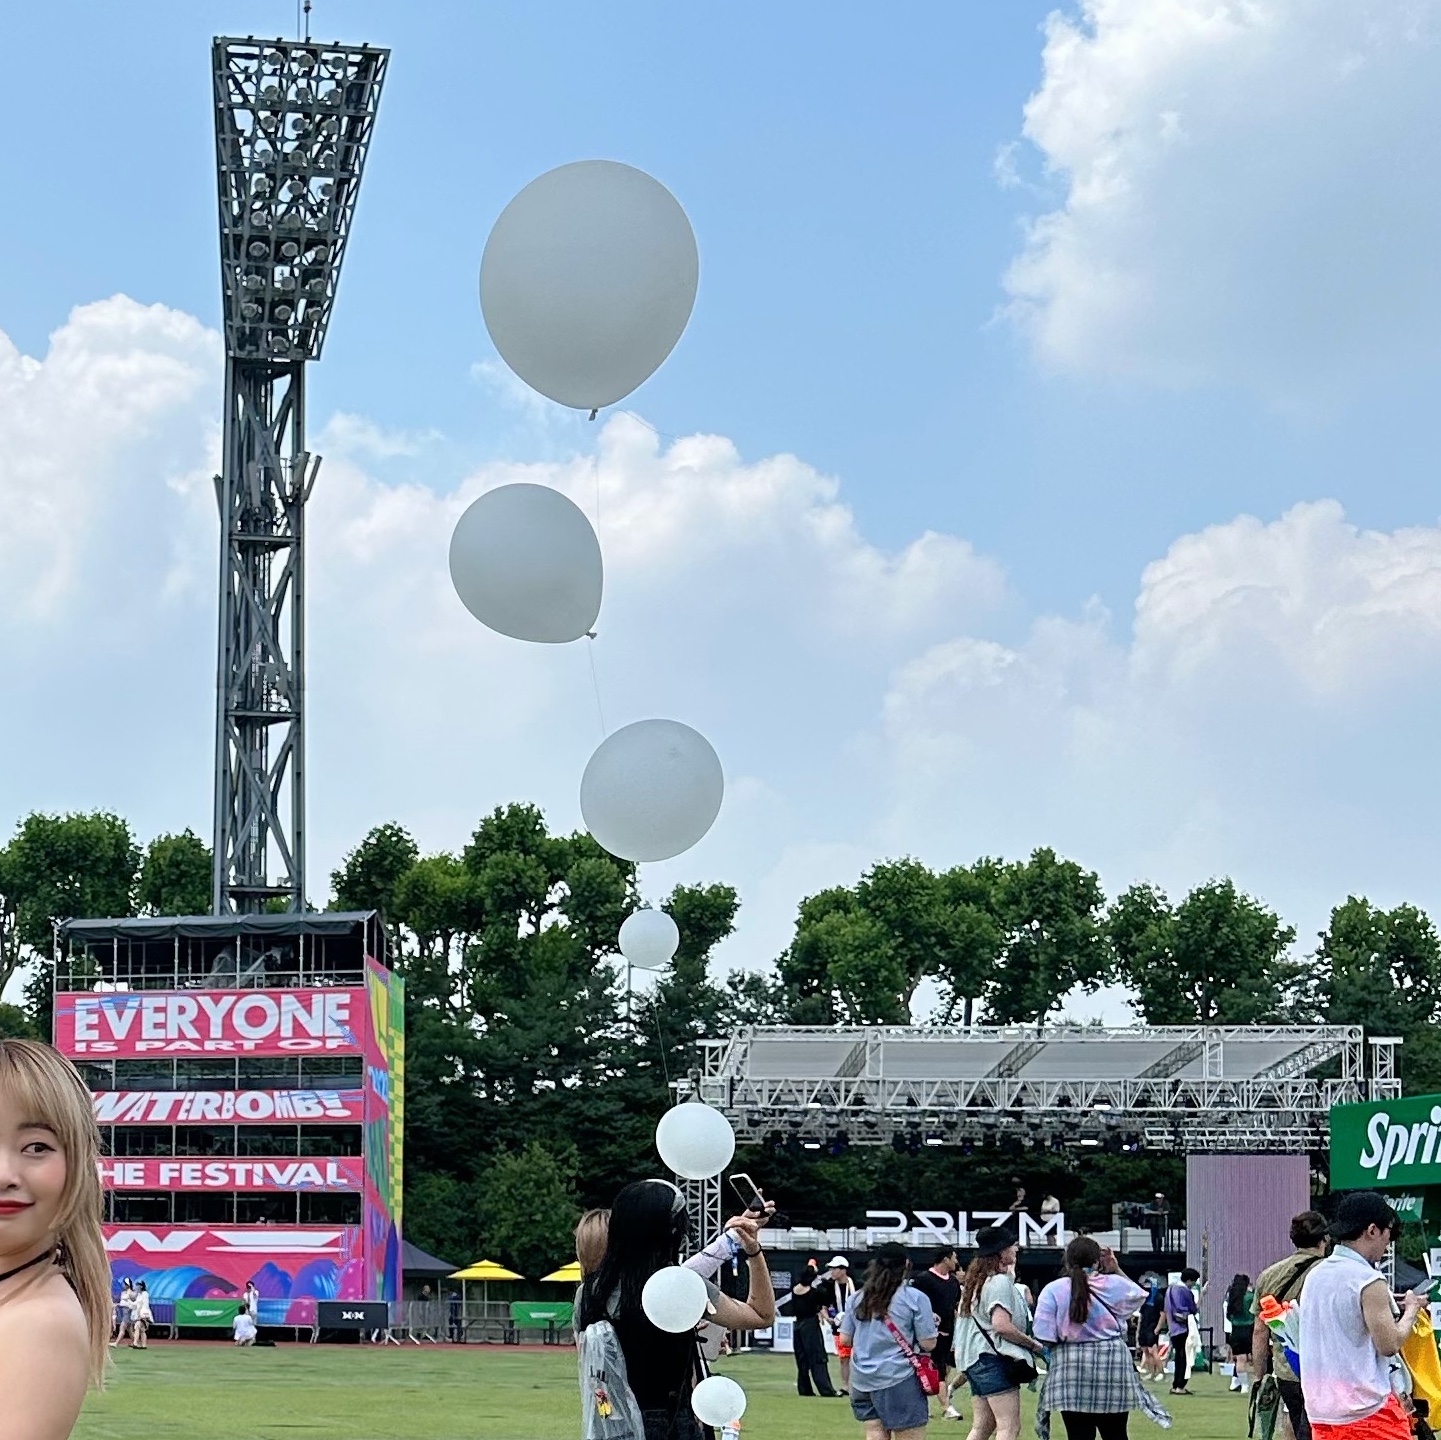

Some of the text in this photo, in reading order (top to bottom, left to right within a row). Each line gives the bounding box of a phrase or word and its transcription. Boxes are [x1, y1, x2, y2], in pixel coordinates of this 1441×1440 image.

[74, 993, 351, 1040] EVERYONE
[74, 1038, 351, 1052] IS PART OF
[1359, 1105, 1441, 1180] Spri
[97, 1162, 349, 1186] HE FESTIVAL
